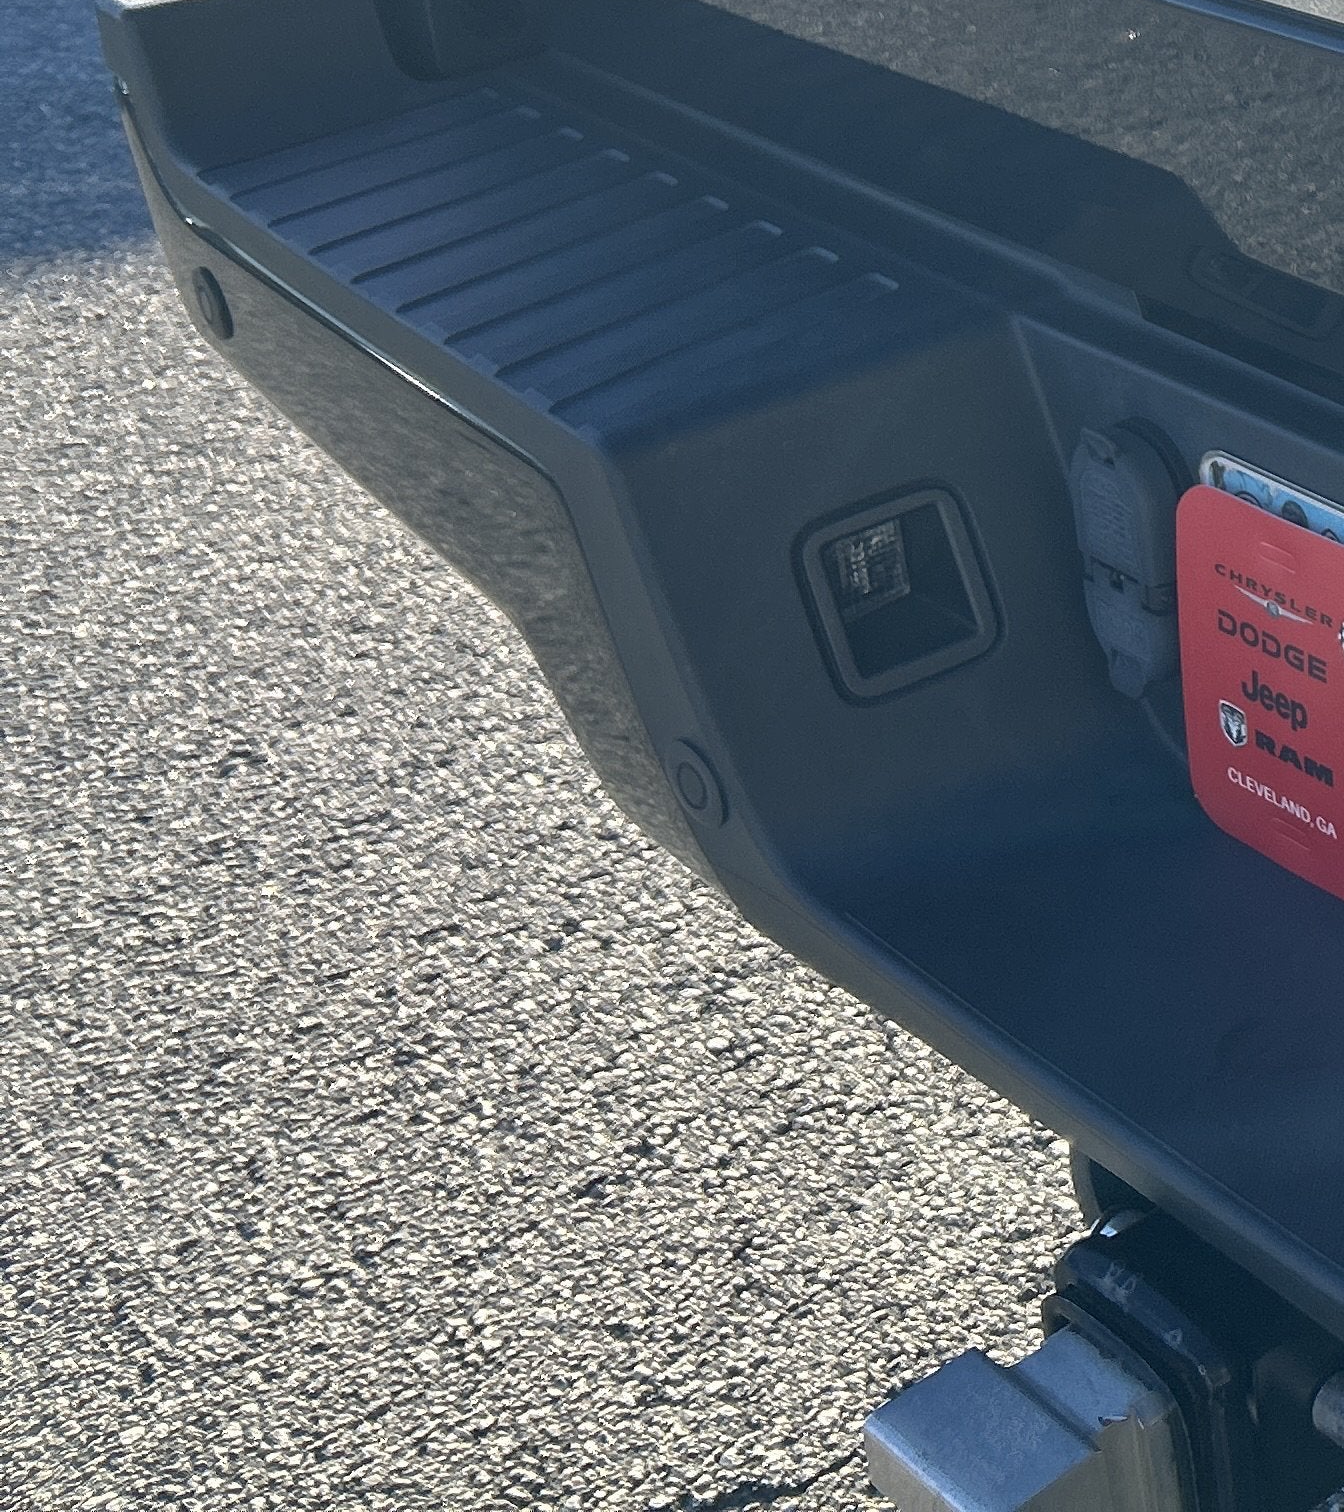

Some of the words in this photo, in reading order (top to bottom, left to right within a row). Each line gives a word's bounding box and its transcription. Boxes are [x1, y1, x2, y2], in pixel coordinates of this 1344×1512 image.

[1214, 563, 1334, 628] CHRYSLER
[1217, 608, 1328, 684] DODGE
[1241, 670, 1308, 732] Jeep
[1254, 728, 1335, 788] RAM
[1227, 766, 1315, 828] CLEVELAND,
[1315, 815, 1338, 840] GA
